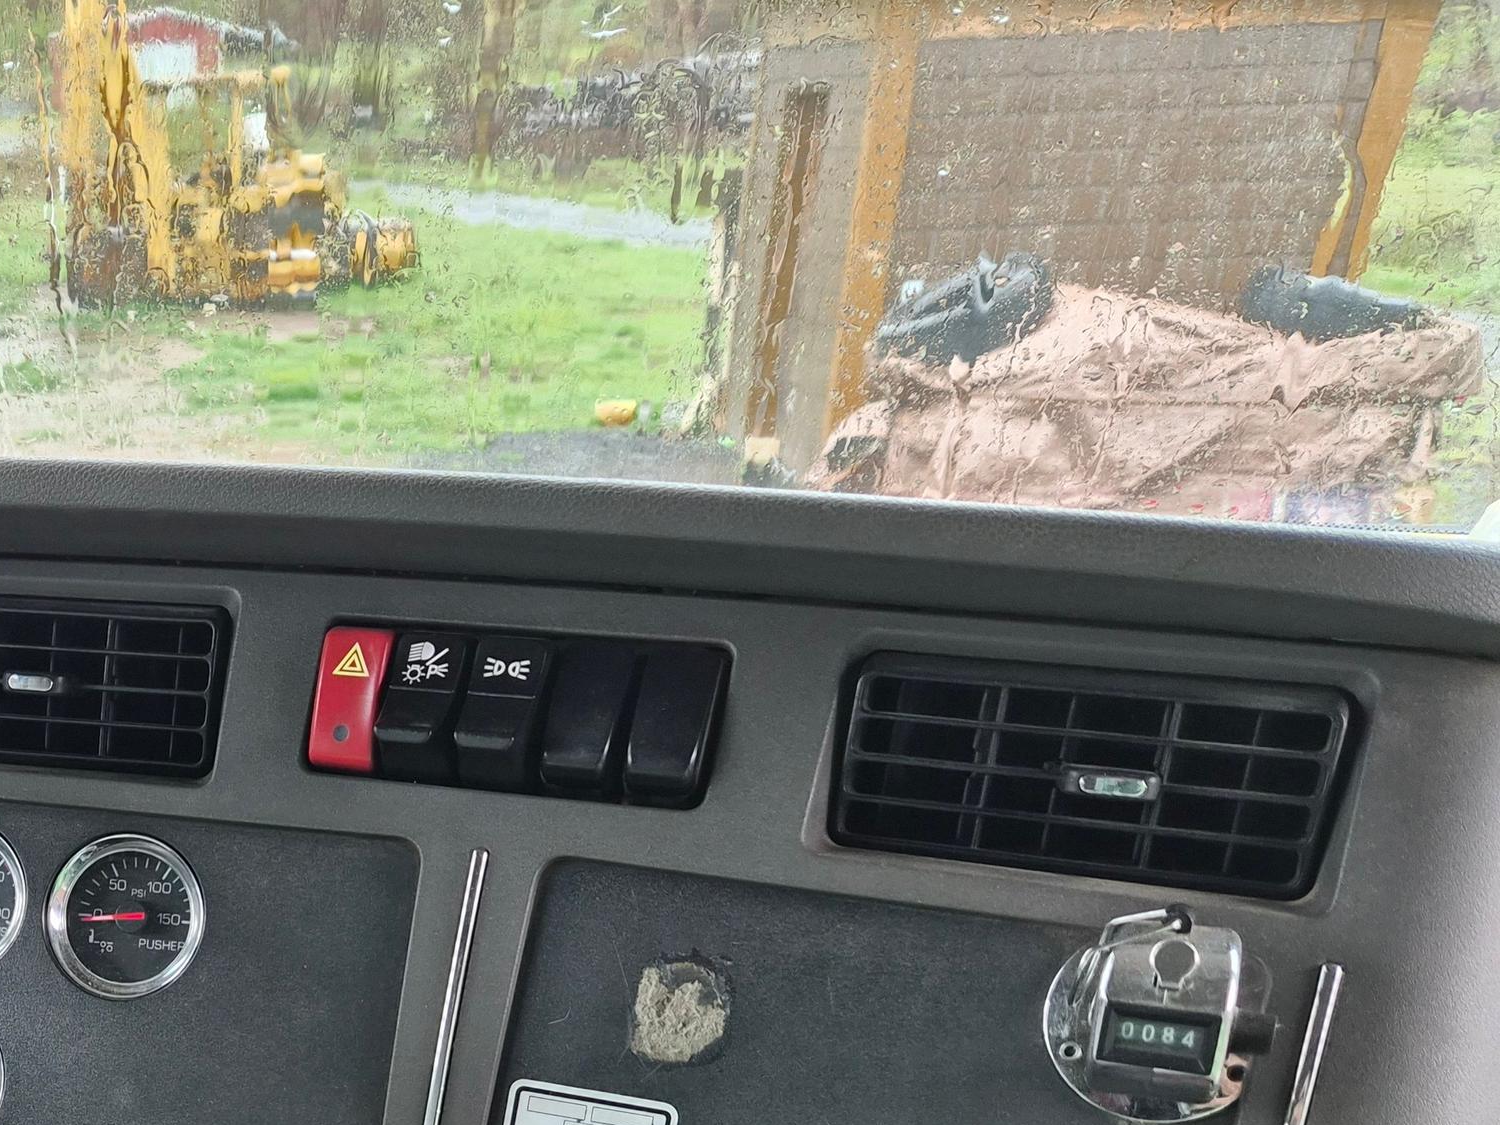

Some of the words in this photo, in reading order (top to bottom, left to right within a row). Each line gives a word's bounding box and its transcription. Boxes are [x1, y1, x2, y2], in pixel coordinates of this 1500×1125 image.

[109, 879, 127, 891] 50
[147, 881, 172, 894] 100
[131, 888, 147, 898] PSI
[157, 913, 181, 926] 150
[1121, 1021, 1197, 1048] 0084
